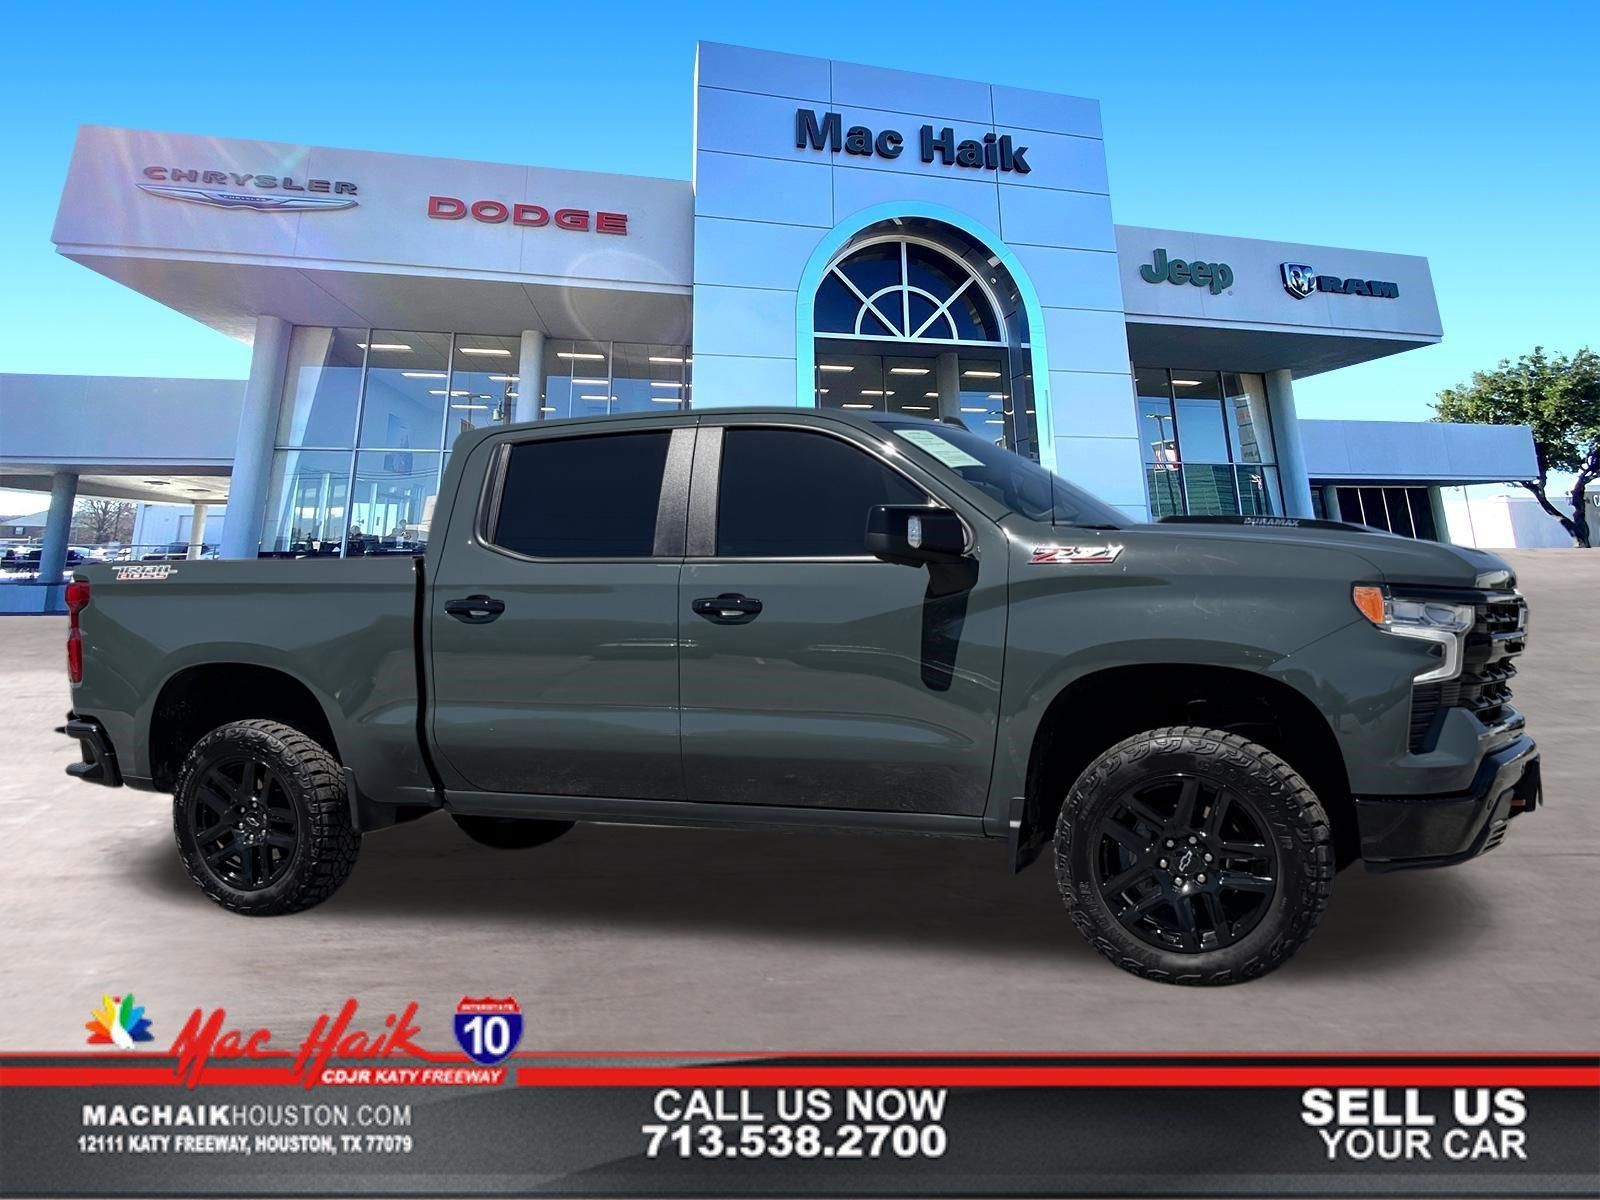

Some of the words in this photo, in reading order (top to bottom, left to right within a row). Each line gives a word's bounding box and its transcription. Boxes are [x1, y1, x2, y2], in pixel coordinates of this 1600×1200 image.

[796, 108, 904, 159] Mac
[920, 124, 1032, 174] Haik
[142, 165, 359, 196] CHRYSLER
[427, 195, 628, 236] DODGE
[1139, 248, 1234, 295] Jeep
[1316, 275, 1400, 299] RAM
[1243, 517, 1300, 528] DURAMAX
